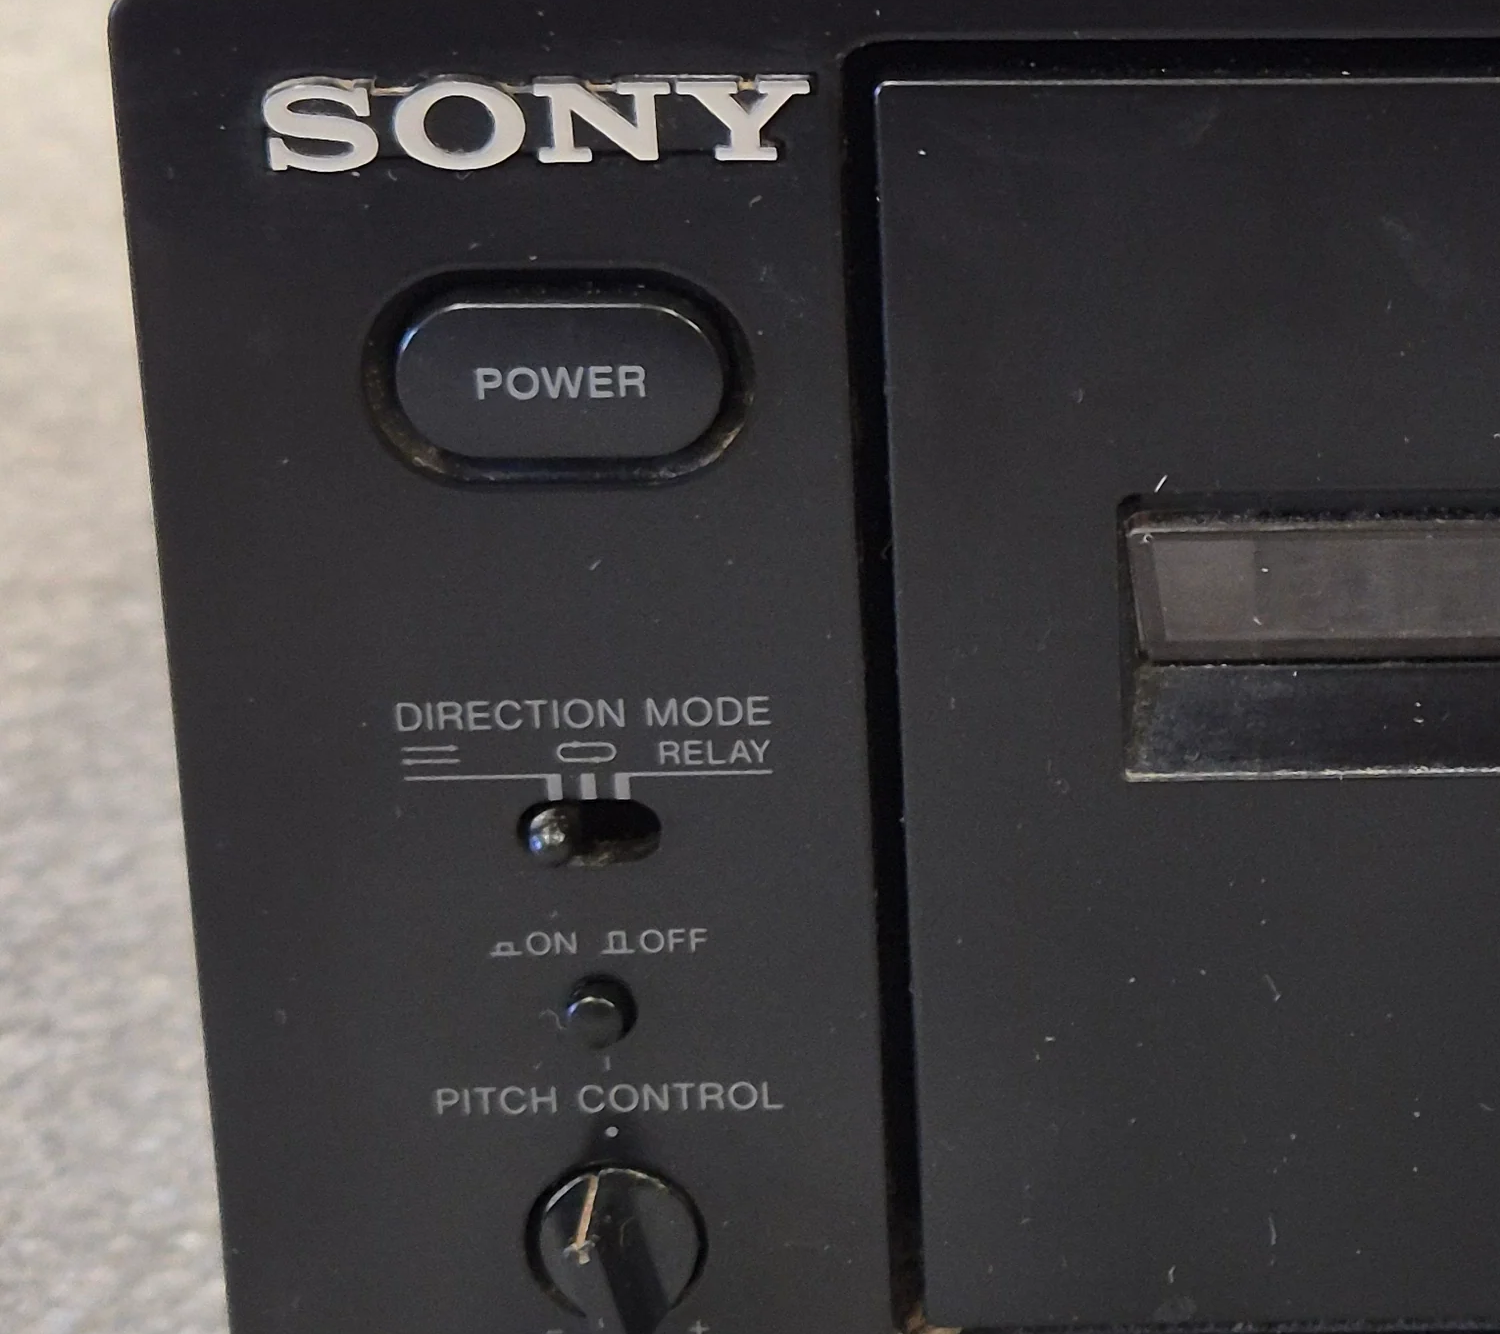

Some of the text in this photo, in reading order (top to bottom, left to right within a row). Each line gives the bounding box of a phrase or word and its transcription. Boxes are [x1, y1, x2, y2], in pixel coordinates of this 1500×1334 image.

[262, 75, 810, 172] SONY
[476, 365, 647, 400] POWER
[395, 696, 771, 732] DIRECTION MODE
[658, 740, 771, 766] RELAY
[525, 931, 577, 955] ON
[639, 928, 708, 954] OFF
[435, 1082, 783, 1115] PITCH CONTROL
